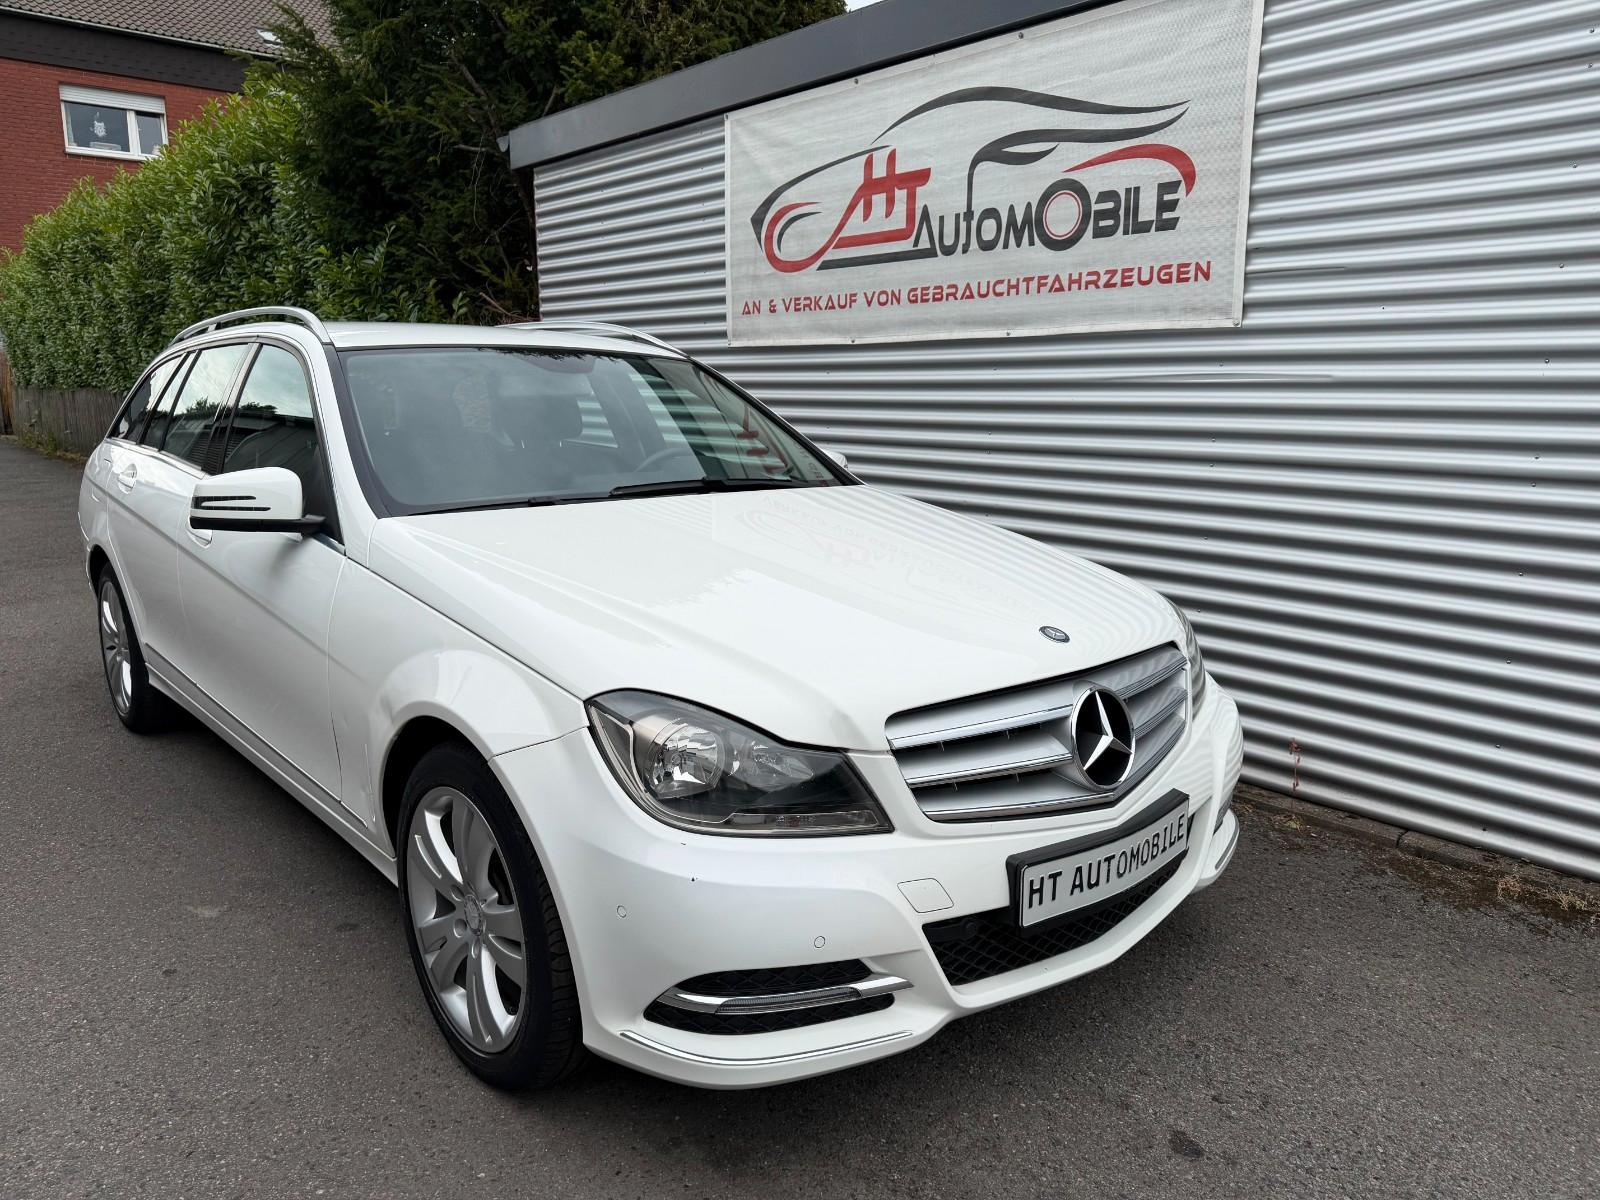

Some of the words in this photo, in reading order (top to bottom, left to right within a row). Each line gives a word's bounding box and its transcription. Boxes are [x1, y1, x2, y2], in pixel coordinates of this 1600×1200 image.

[837, 147, 932, 248] HT
[912, 178, 1183, 257] AUTOMOBILE
[742, 300, 761, 316] AN
[768, 298, 777, 314] &
[782, 293, 858, 313] VERKAUF
[864, 288, 902, 308] VON
[907, 260, 1212, 305] GEBRAUCHTFAHRZEUGEN
[1028, 870, 1063, 909] HT
[1069, 813, 1185, 896] AUTOMOBILE
